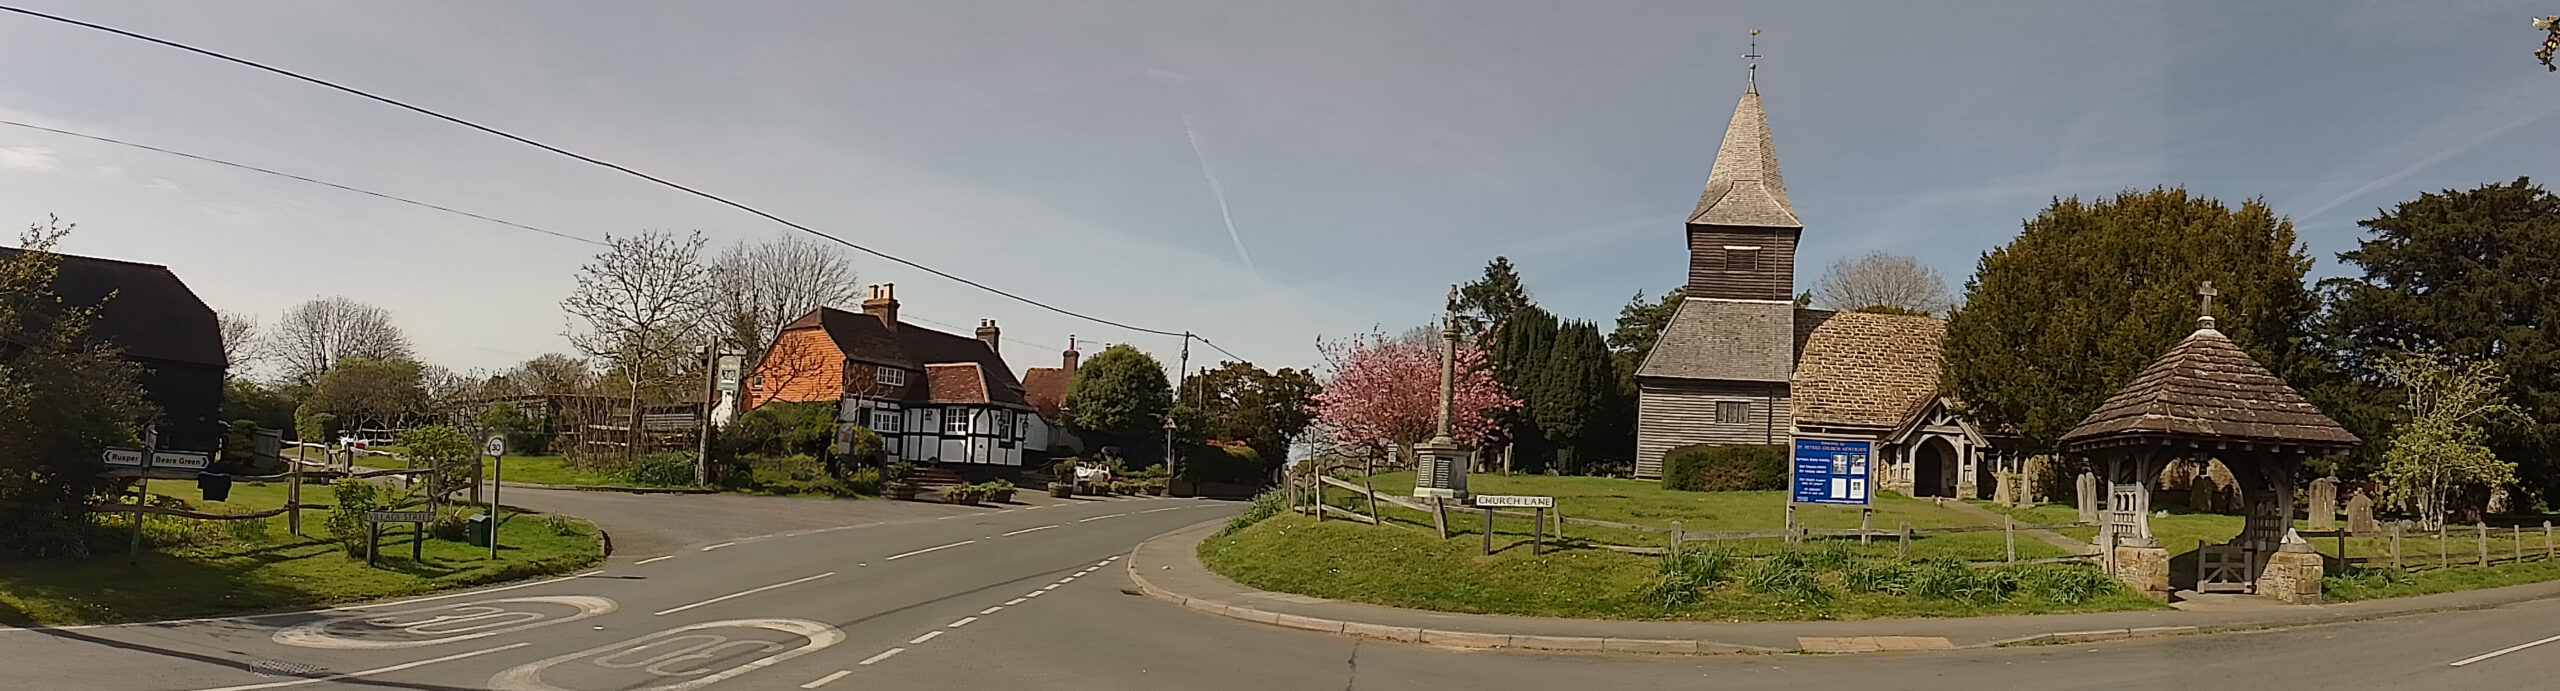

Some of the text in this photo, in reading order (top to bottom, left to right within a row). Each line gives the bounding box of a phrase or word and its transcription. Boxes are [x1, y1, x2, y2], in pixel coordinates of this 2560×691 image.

[112, 453, 139, 462] Rusper
[155, 456, 200, 465] Beare Green
[1478, 496, 1550, 506] CHURCH LANE
[368, 513, 433, 521] VILLAGE STREET
